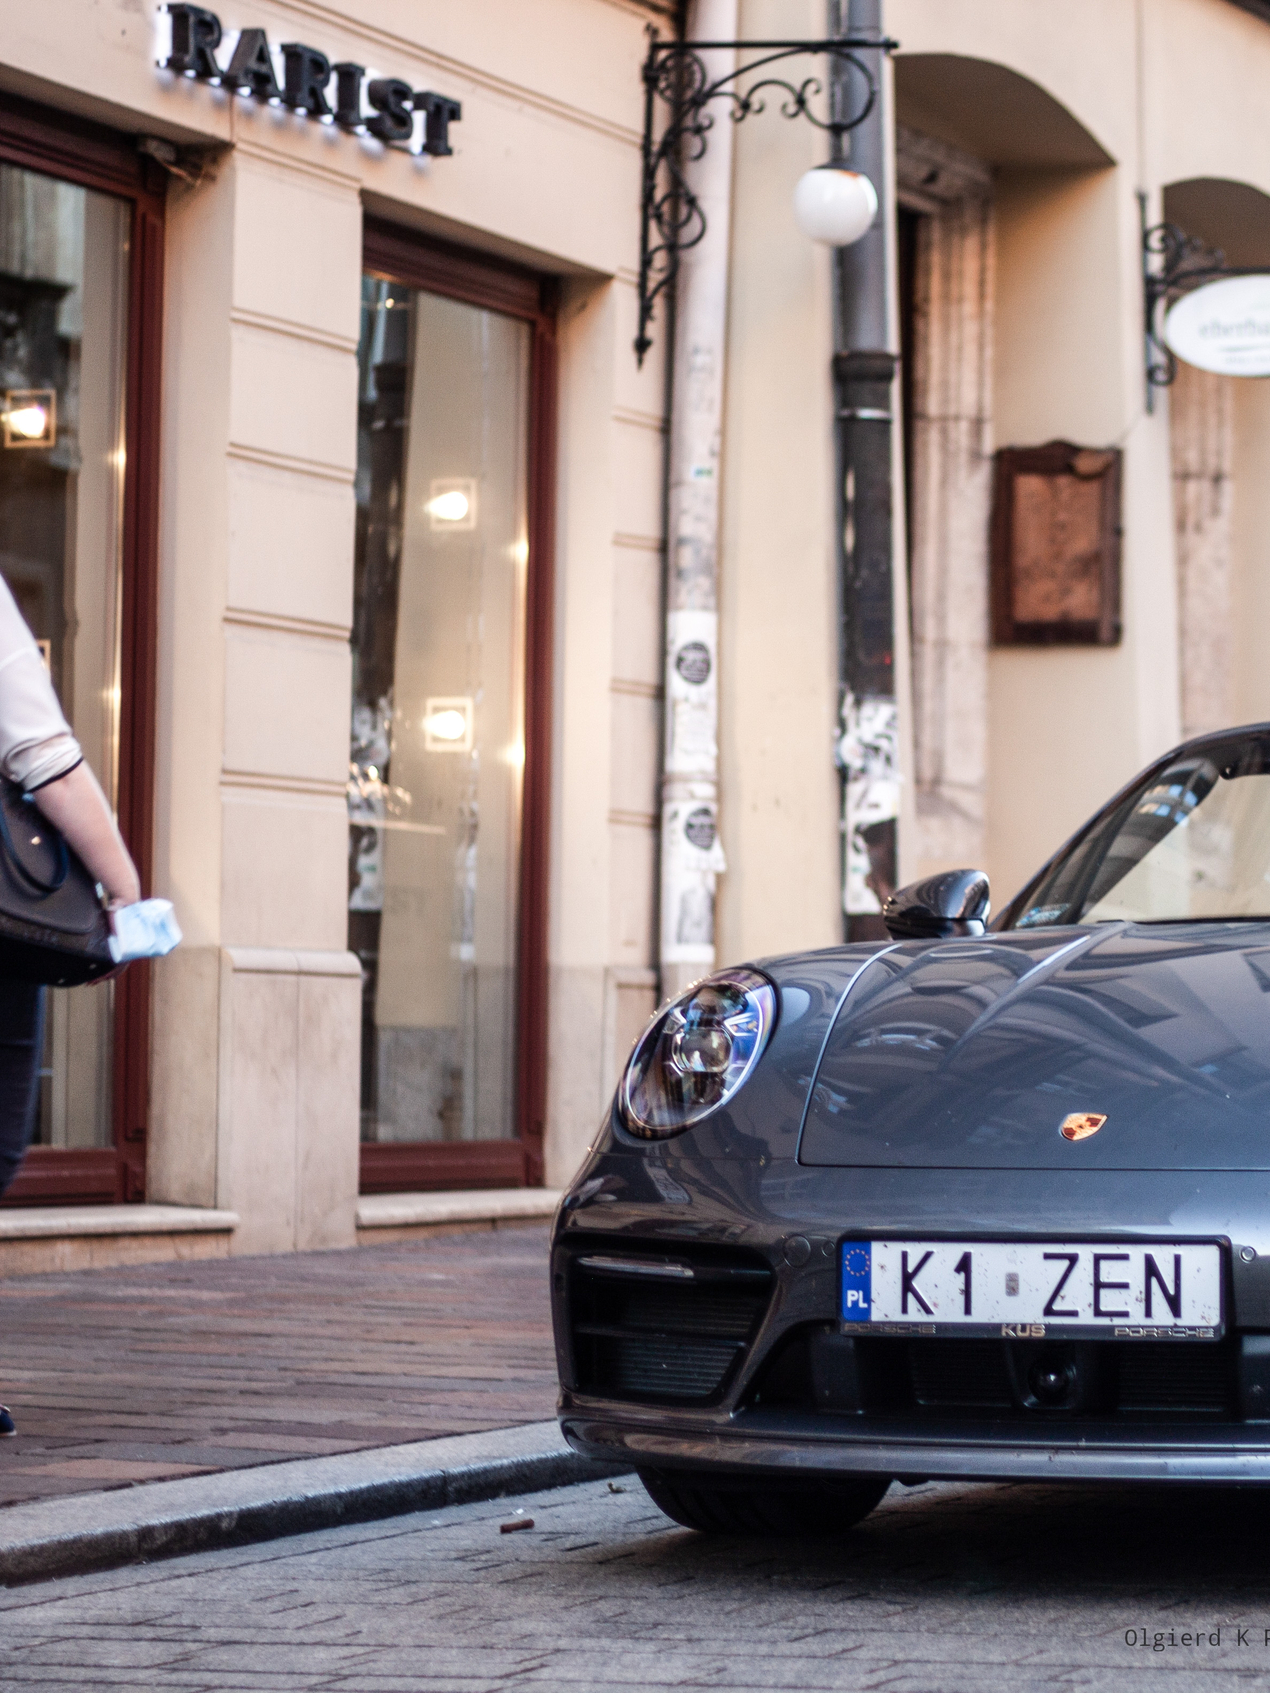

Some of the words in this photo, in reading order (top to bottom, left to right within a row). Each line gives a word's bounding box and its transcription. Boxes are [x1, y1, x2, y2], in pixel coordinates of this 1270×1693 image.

[156, 3, 461, 156] RARIST
[847, 1290, 868, 1308] PL
[901, 1250, 972, 1316] K1
[1043, 1252, 1182, 1318] ZEN
[845, 1323, 936, 1334] PORSCHE
[1001, 1324, 1046, 1338] KUS
[1114, 1326, 1215, 1338] PORSCHE
